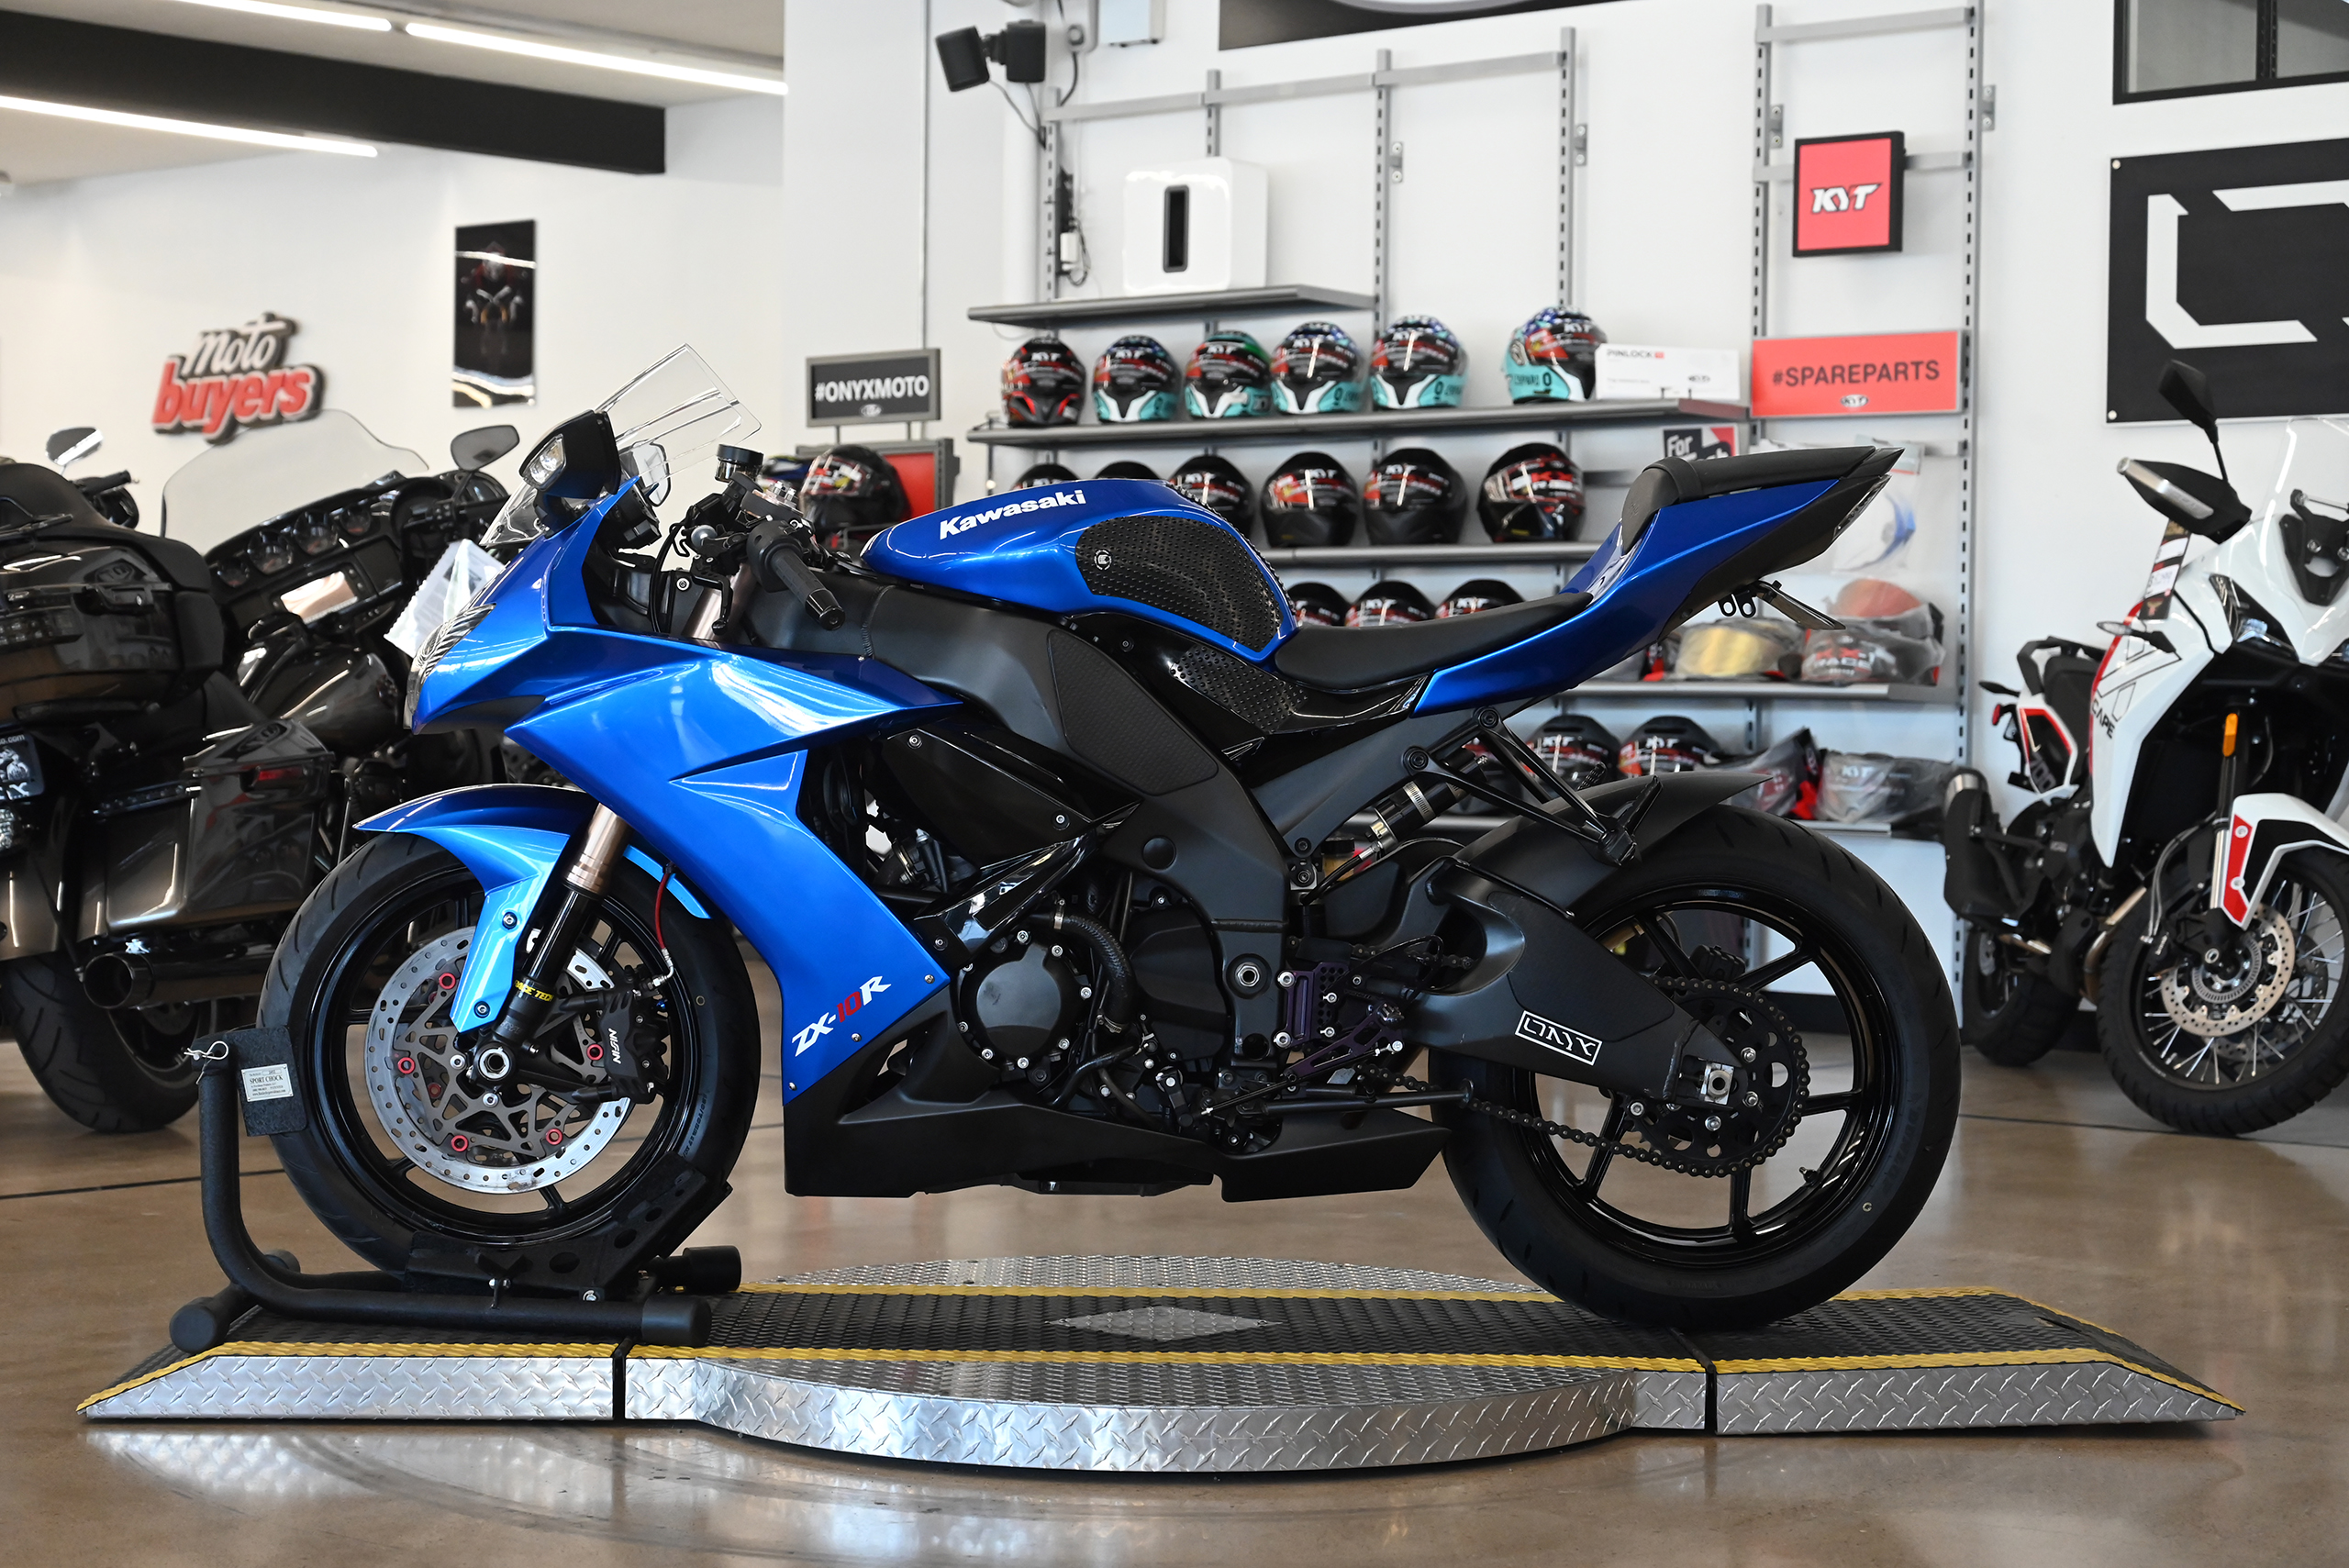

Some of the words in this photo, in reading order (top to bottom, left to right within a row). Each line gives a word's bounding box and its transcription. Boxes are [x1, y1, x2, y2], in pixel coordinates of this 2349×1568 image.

[1810, 183, 1883, 214] KYT
[1772, 360, 1941, 387] #SPAREPARTS
[151, 356, 316, 438] buyers
[814, 374, 930, 403] #ONYXMOTO
[1666, 434, 1694, 459] For
[939, 489, 1087, 540] Kawasaki
[0, 734, 26, 745] o.com
[791, 975, 892, 1057] ZX-10R
[265, 1074, 284, 1083] CHOCK
